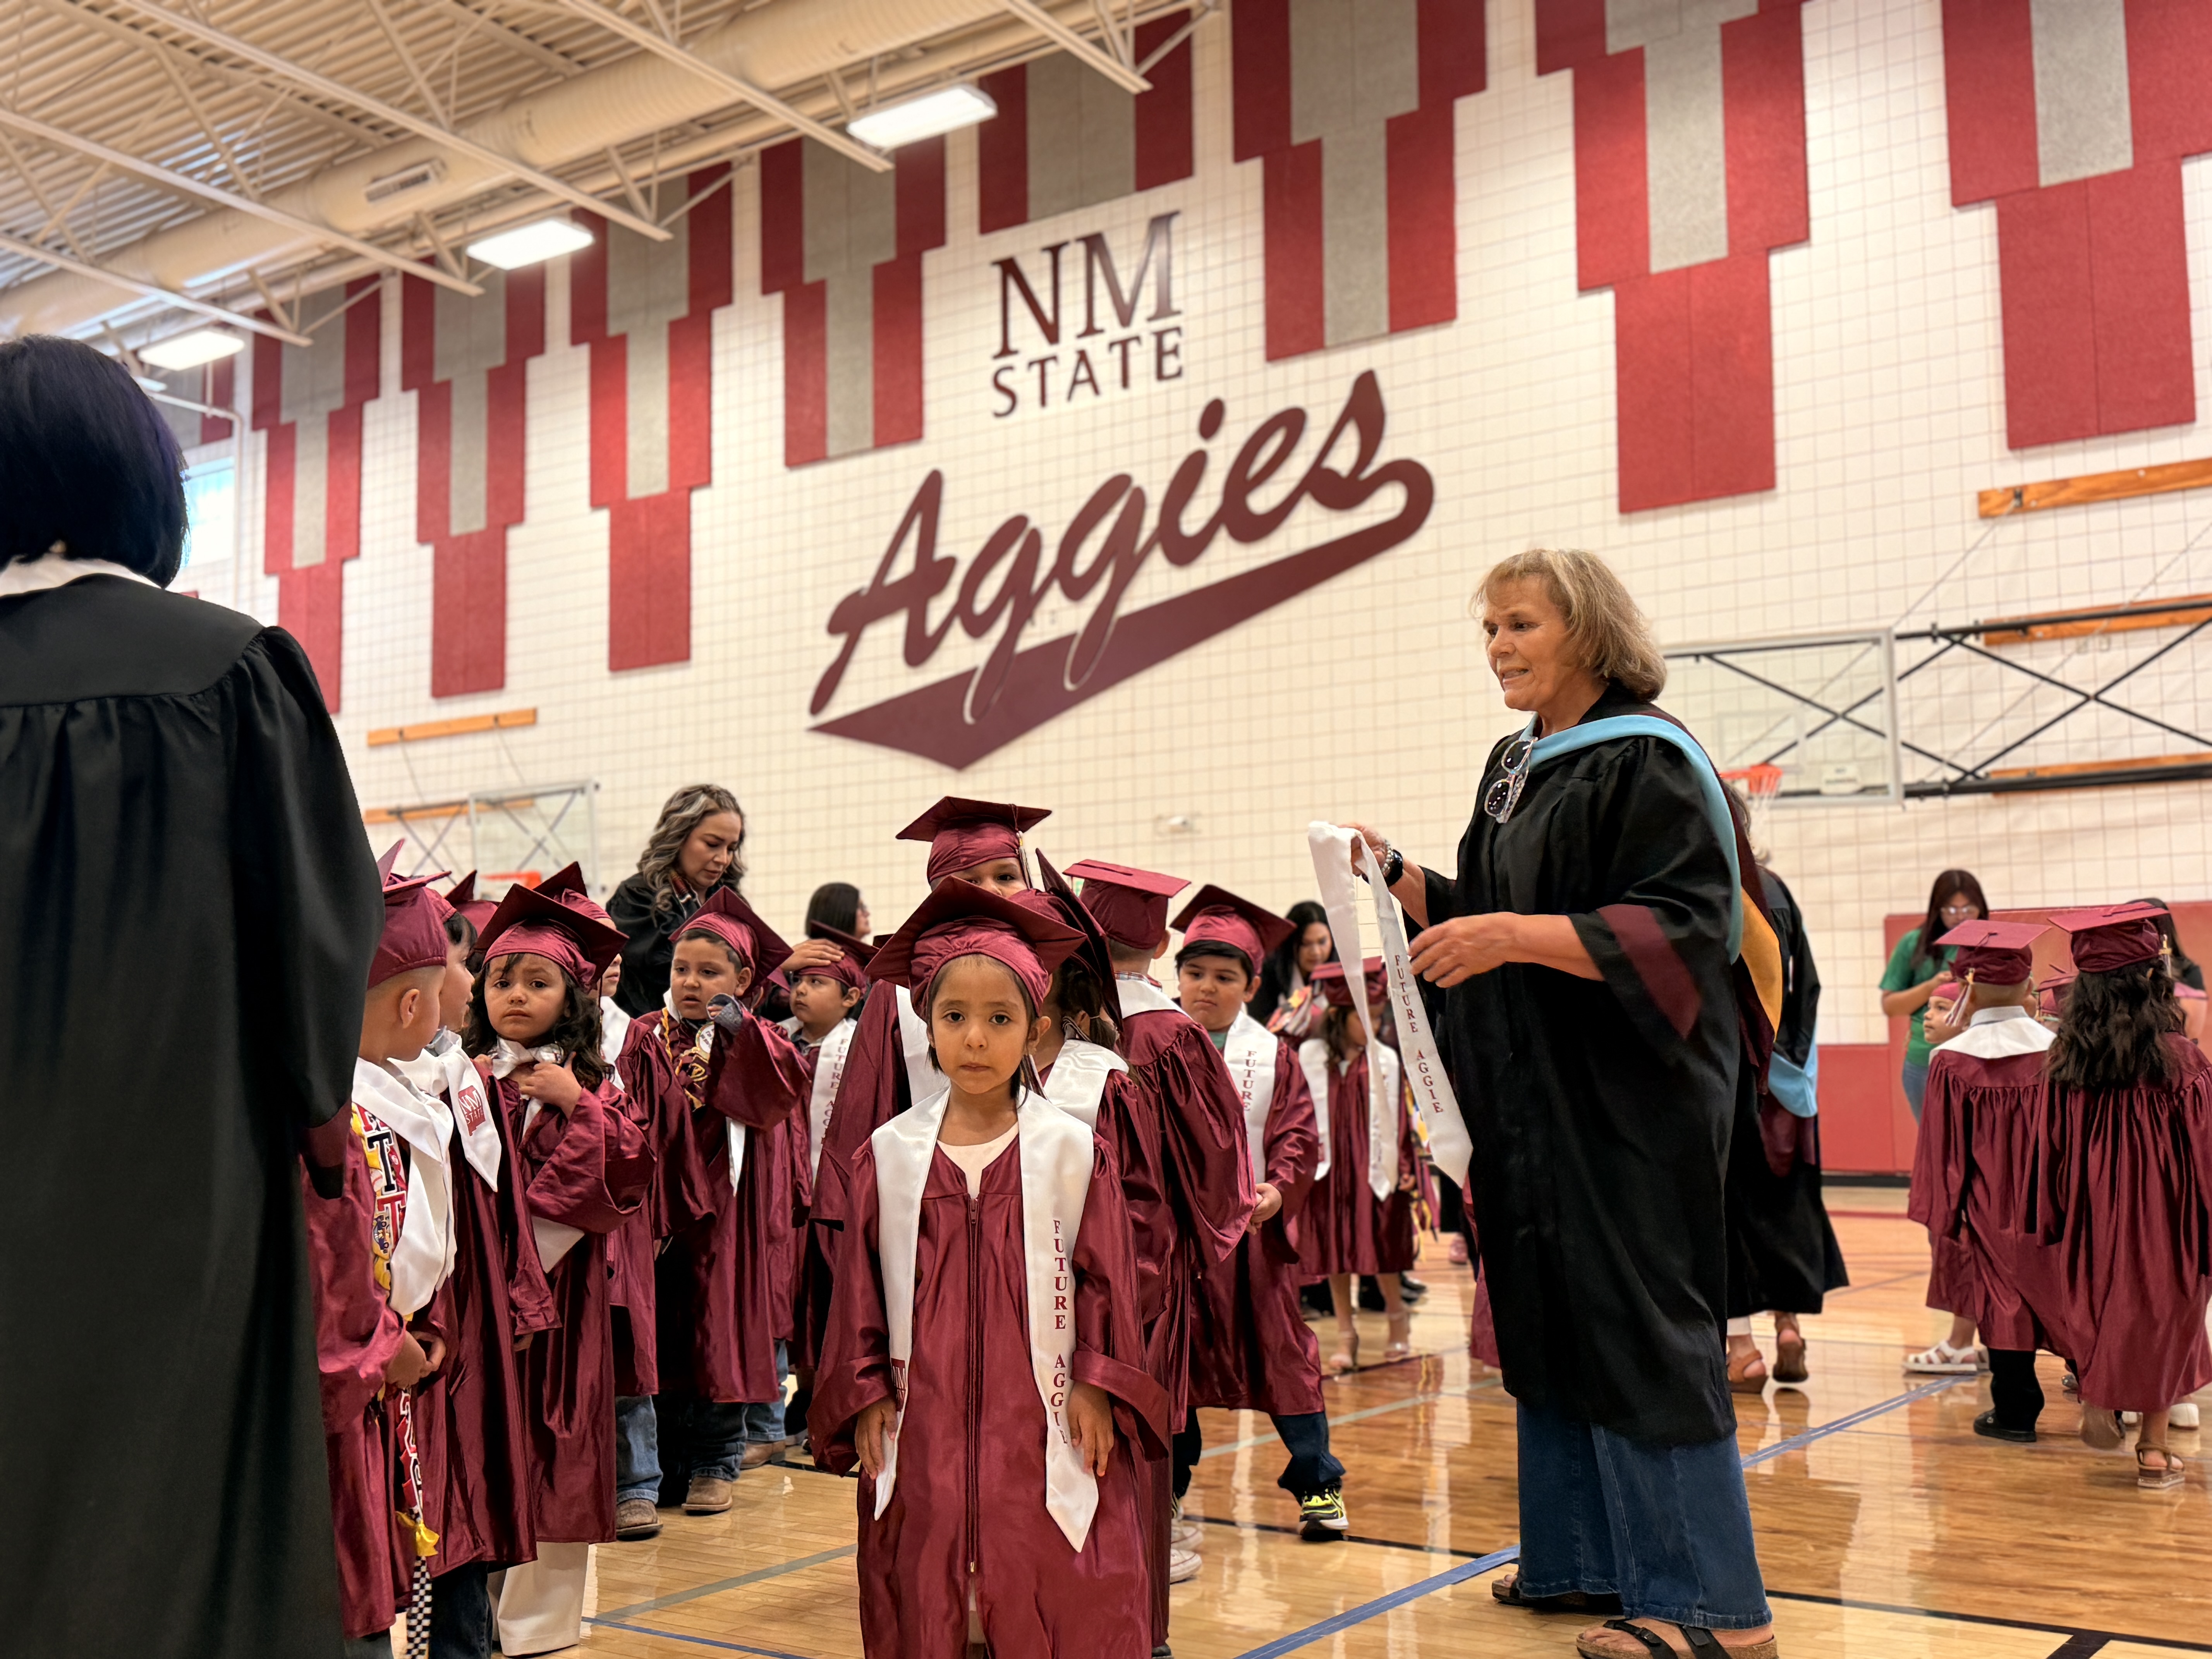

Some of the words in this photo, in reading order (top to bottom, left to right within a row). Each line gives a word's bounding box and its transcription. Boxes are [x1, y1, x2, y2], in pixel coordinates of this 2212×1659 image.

[990, 210, 1182, 360] NM
[993, 326, 1183, 418] STATE
[809, 369, 1386, 723] Aggies
[831, 1039, 848, 1089] FUTURE
[1241, 1050, 1257, 1111] FUTURE
[1395, 955, 1418, 1033] FUTURE
[1417, 1049, 1443, 1113] AGGIE
[459, 1090, 481, 1114] NM
[1053, 1219, 1068, 1329] FUTURE
